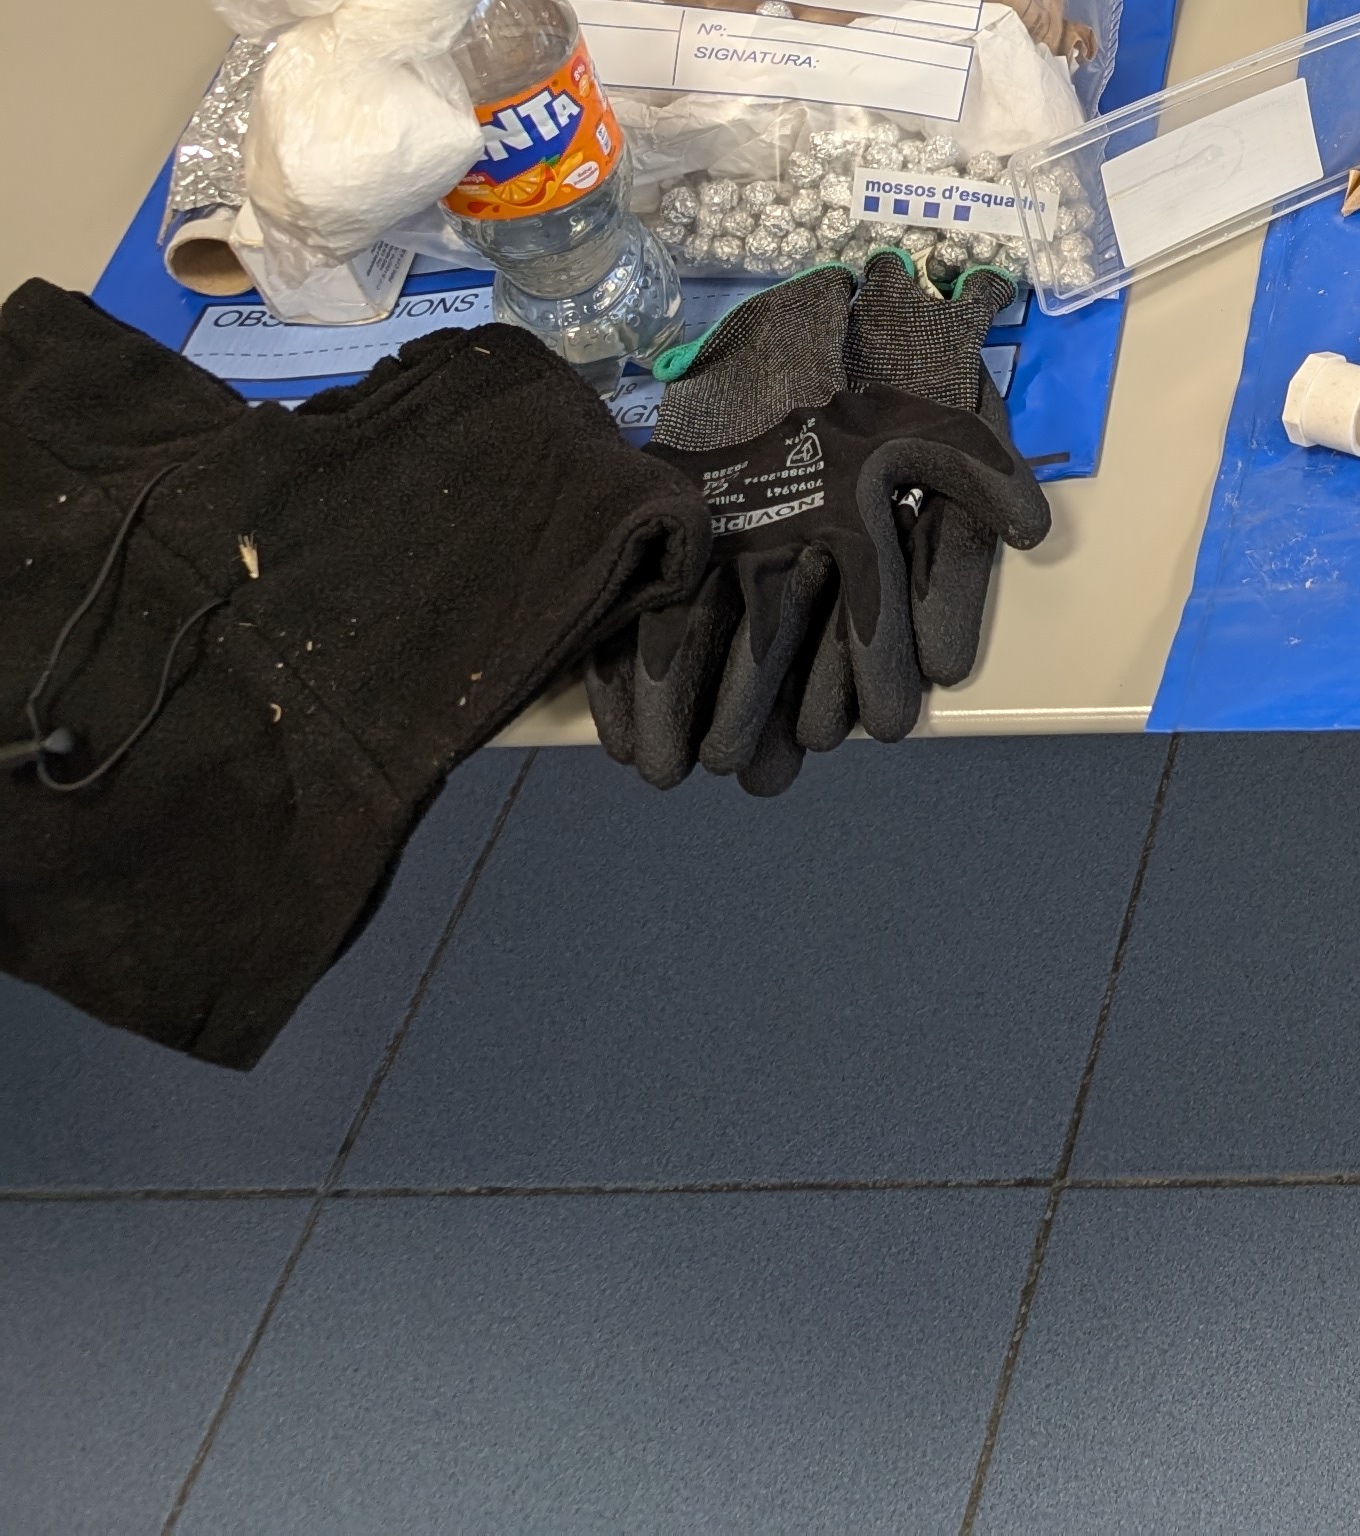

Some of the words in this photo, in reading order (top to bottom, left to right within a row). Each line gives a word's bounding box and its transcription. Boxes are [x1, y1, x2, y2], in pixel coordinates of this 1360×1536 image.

[694, 44, 821, 70] SIGNATURA:
[478, 90, 581, 162] NTA
[864, 178, 938, 198] mossos
[941, 185, 1047, 213] d'esquadra
